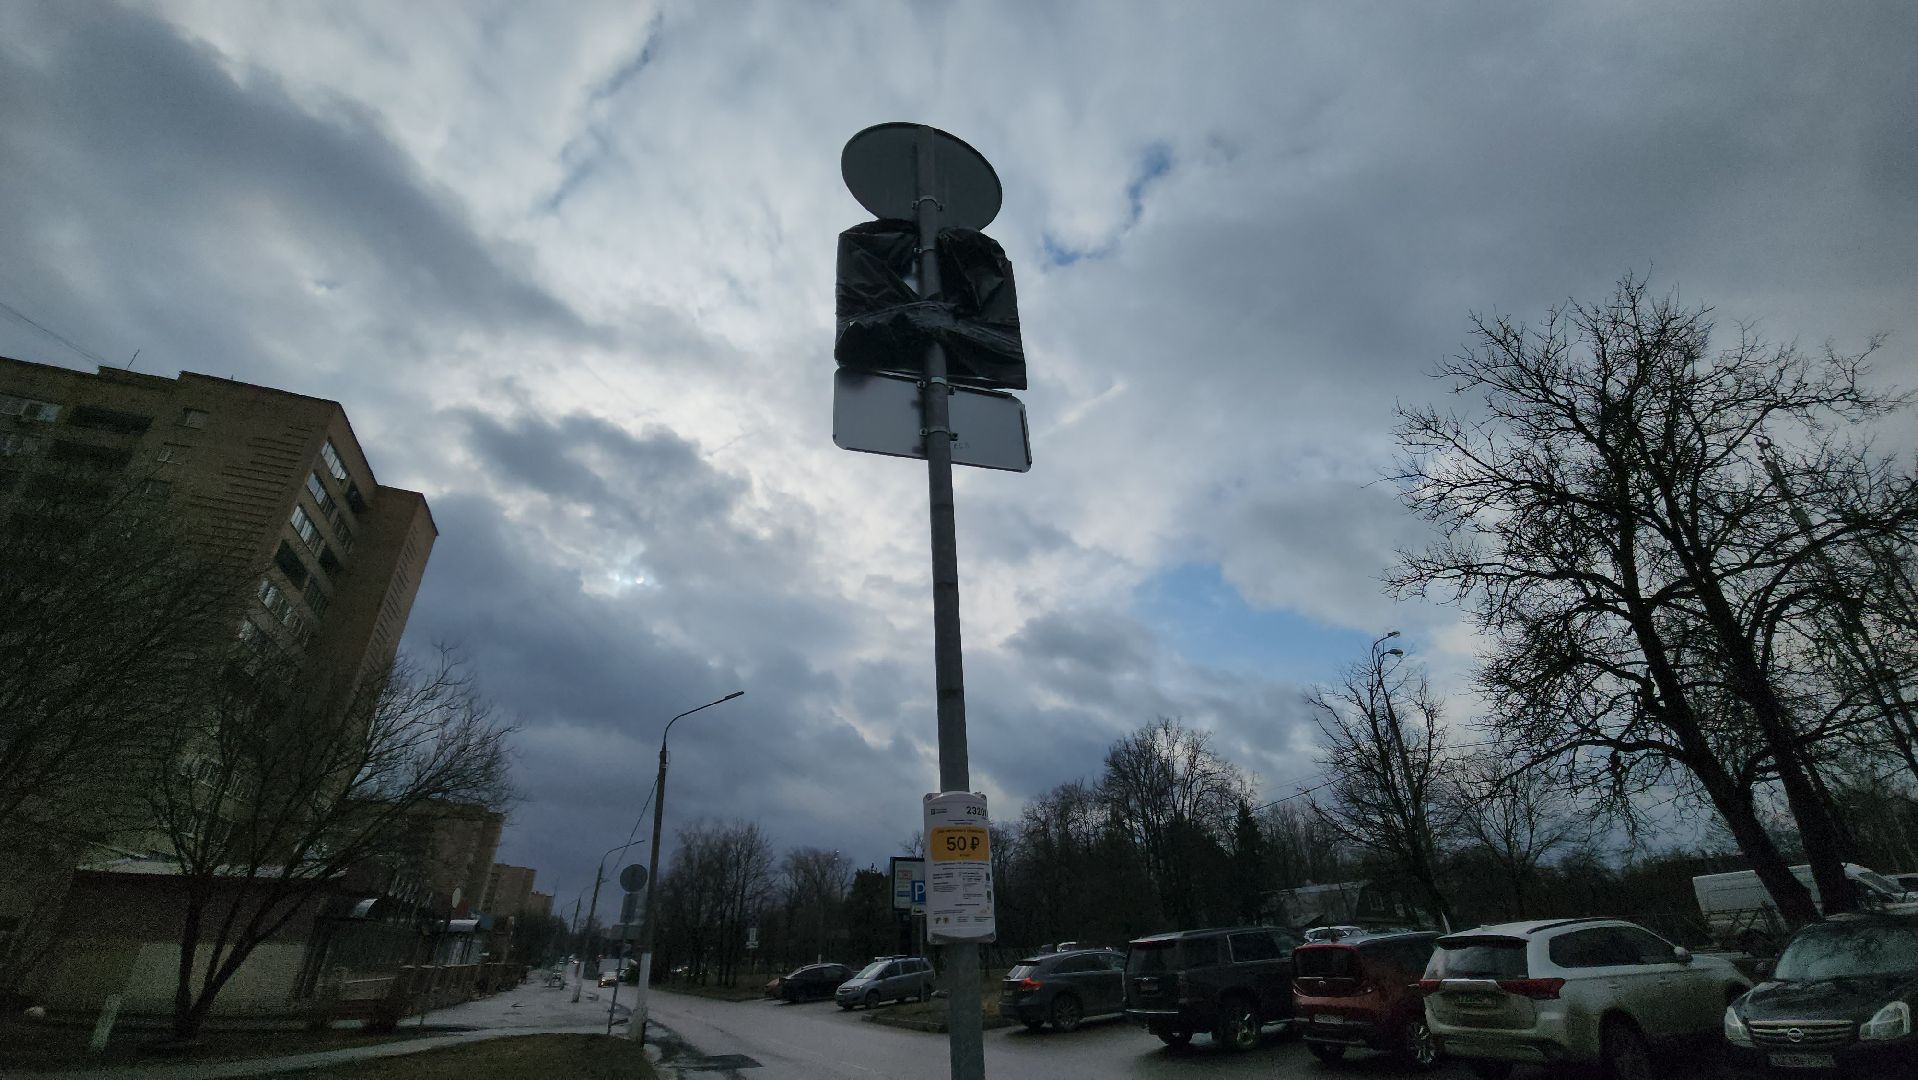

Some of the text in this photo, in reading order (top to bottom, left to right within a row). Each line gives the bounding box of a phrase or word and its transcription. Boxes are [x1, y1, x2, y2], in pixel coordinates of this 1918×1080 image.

[946, 836, 980, 851] 50 ₽
[915, 882, 926, 901] P
